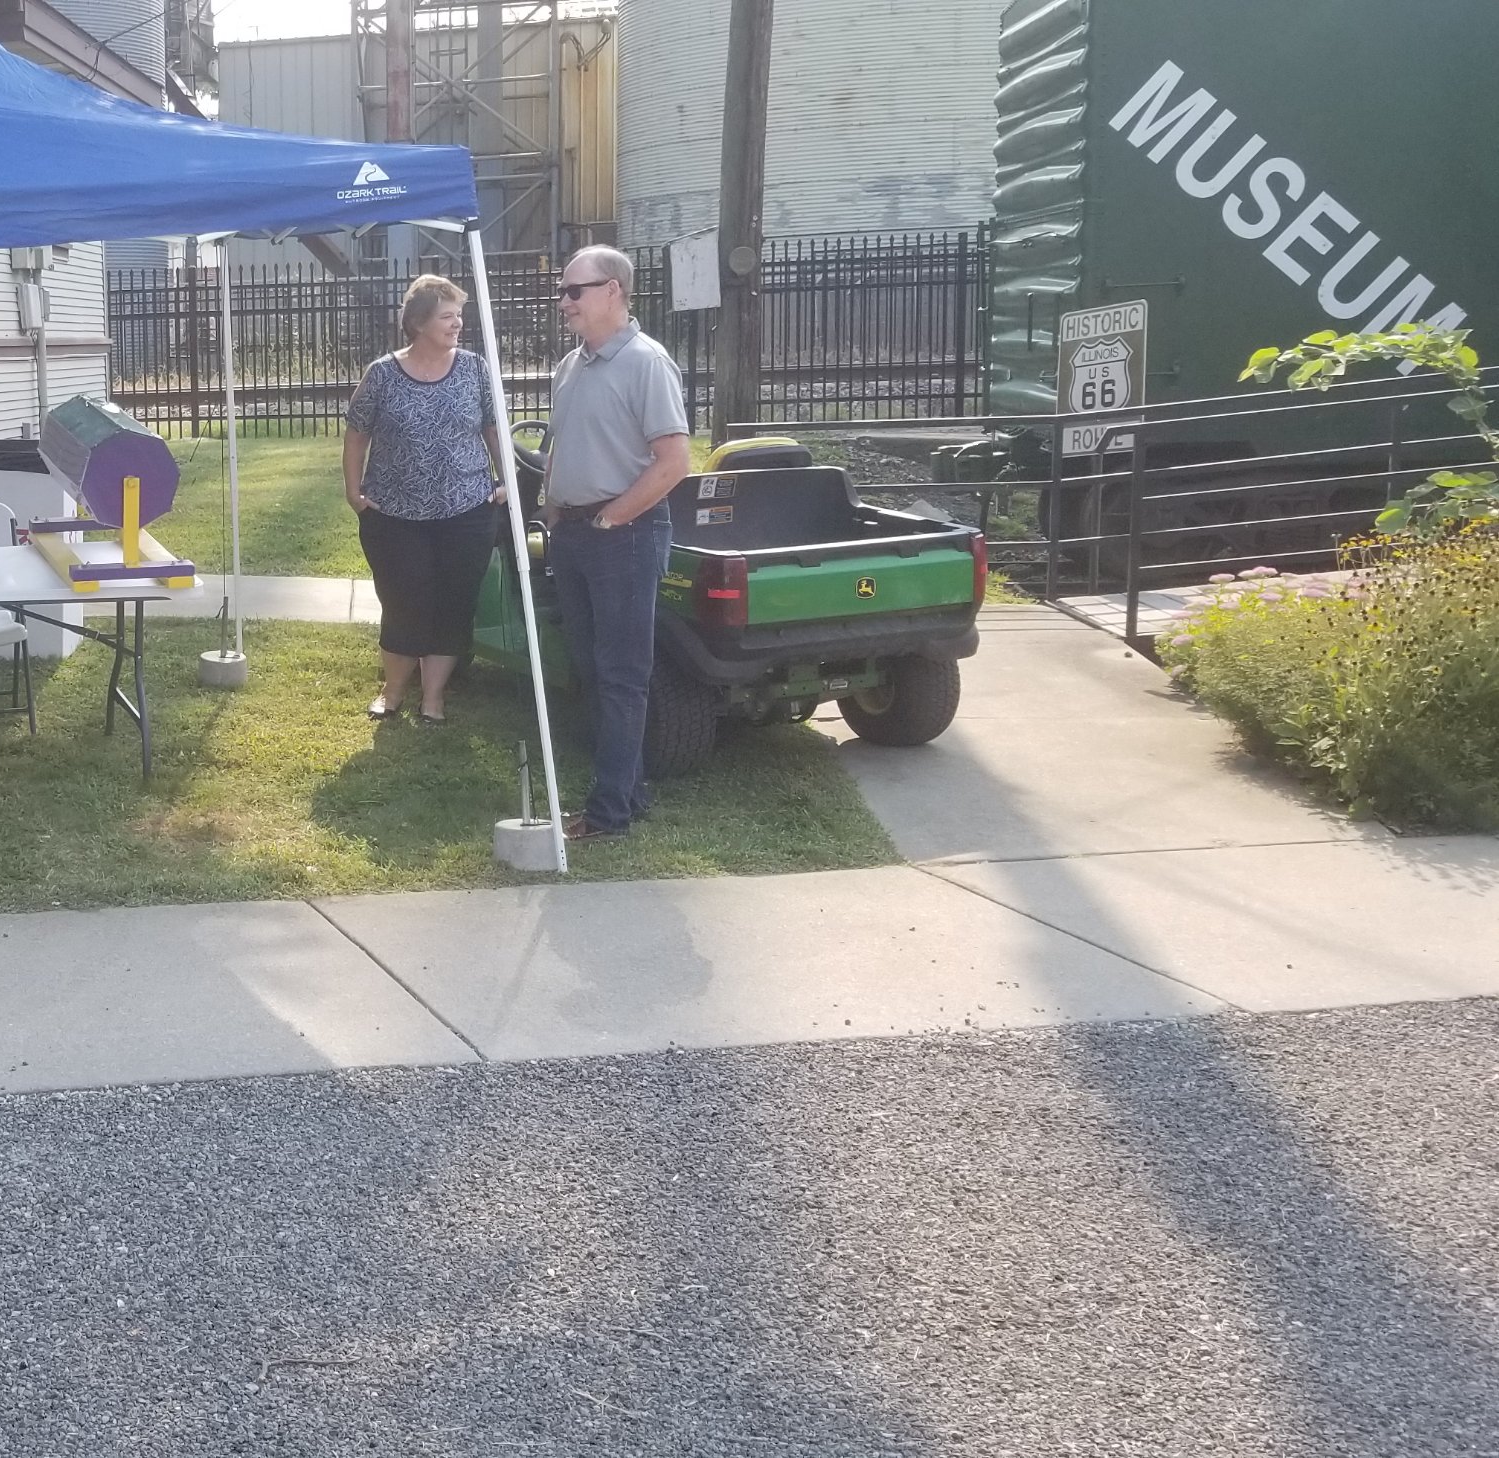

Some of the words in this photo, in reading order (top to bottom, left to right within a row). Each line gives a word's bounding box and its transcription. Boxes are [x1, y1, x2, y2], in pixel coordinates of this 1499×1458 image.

[337, 189, 375, 200] OZARK
[375, 186, 407, 196] TRAIL
[1108, 59, 1468, 376] MUSEUM
[1066, 307, 1139, 340] HISTORIC
[1081, 347, 1119, 363] ILLINOIS
[1081, 379, 1116, 410] 66
[1072, 427, 1123, 450] ROU
